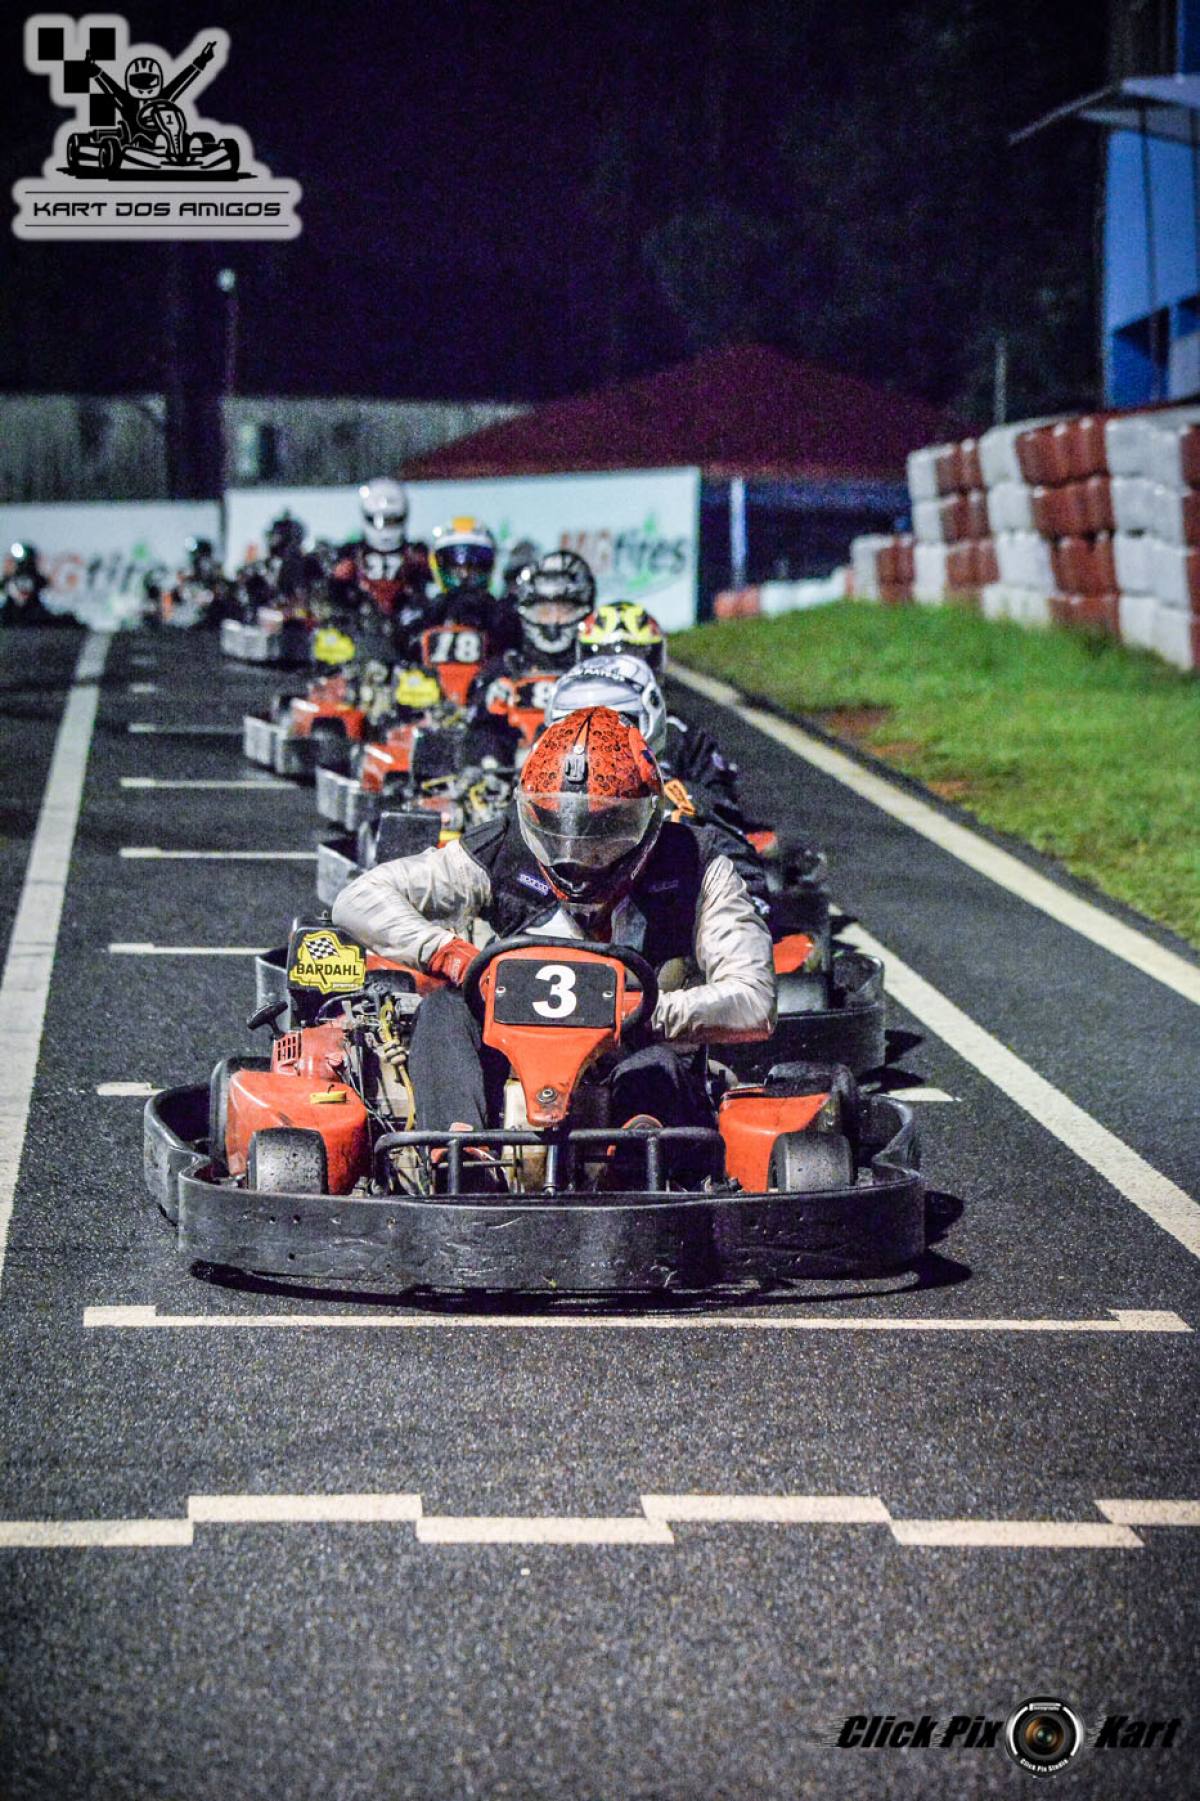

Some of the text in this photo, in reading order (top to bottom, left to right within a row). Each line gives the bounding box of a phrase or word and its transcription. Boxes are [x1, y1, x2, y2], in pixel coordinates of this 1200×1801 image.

[430, 631, 480, 663] 18
[296, 964, 360, 976] BARDAHL
[532, 964, 577, 1018] 3
